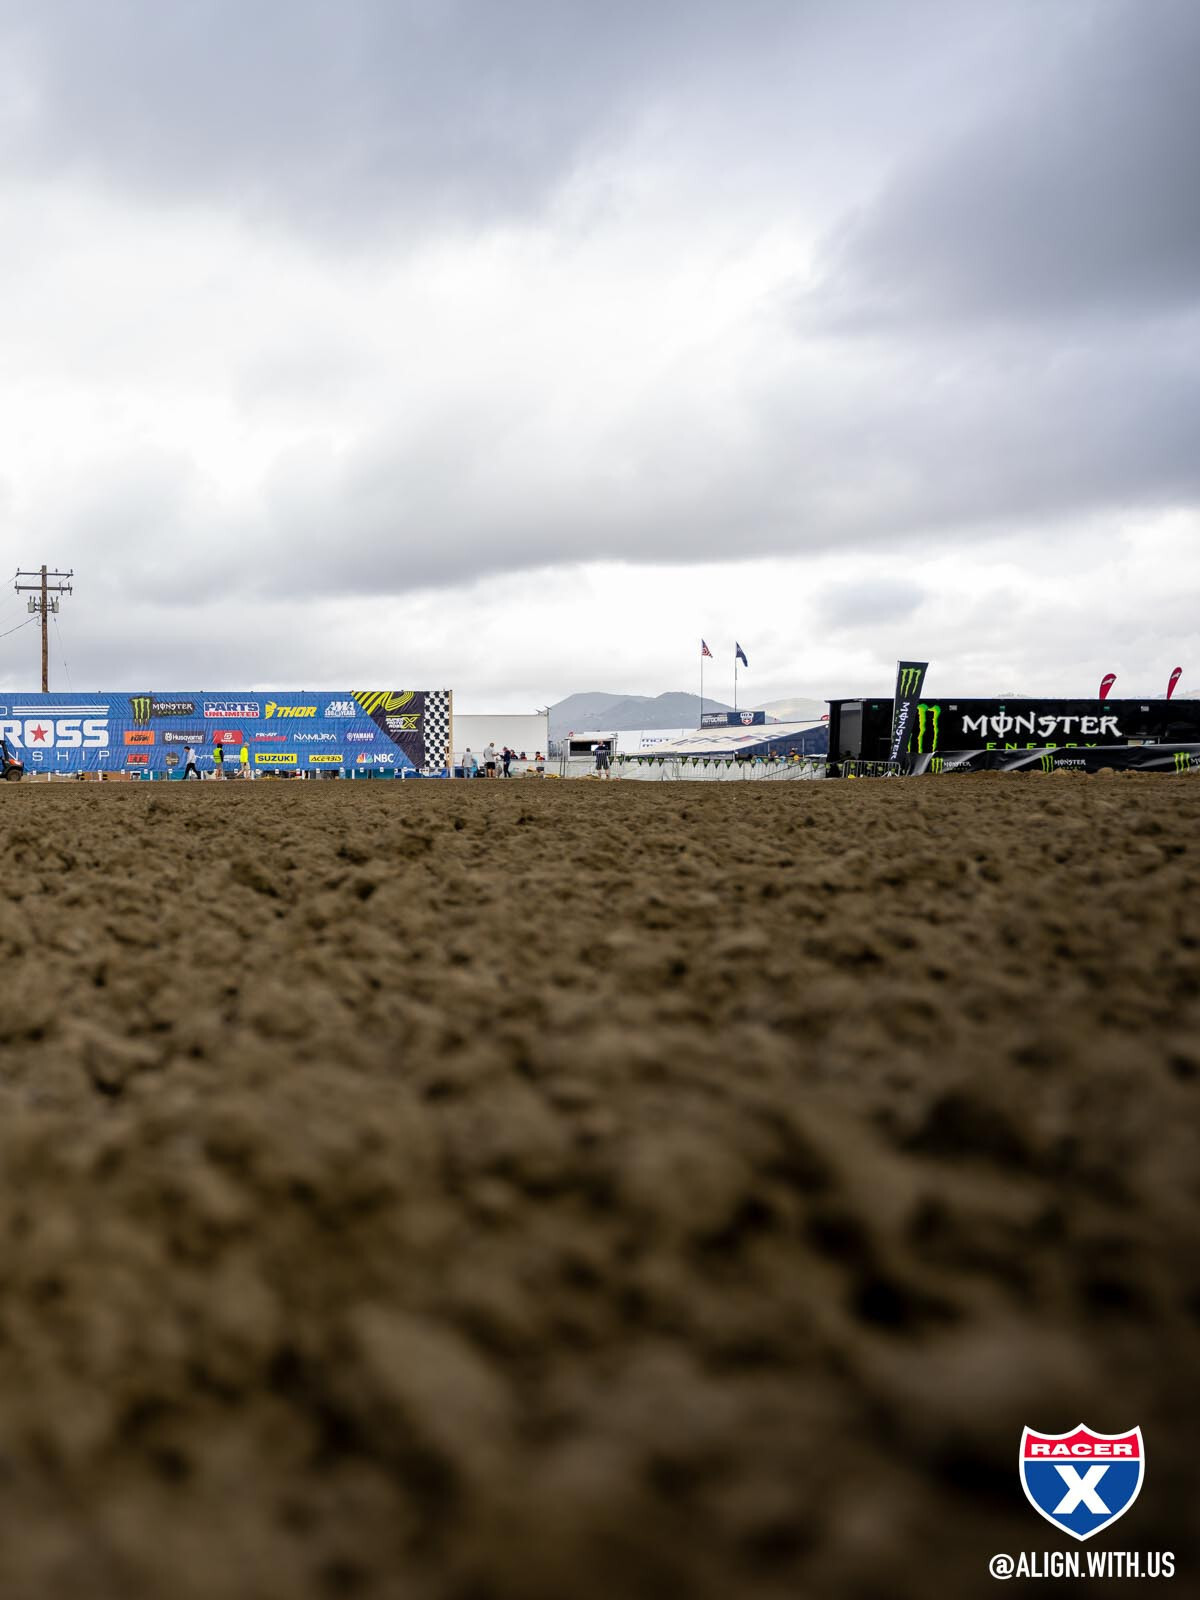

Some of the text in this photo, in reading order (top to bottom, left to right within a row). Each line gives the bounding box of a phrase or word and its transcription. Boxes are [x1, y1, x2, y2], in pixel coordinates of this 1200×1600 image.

[152, 703, 194, 711] MONSTER
[204, 703, 259, 712] PARTS
[325, 701, 355, 711] AMA
[276, 706, 318, 718] THOR
[962, 711, 1123, 738] MONSTER
[890, 702, 910, 760] MONSTER
[293, 732, 337, 742] NAMURA
[373, 753, 395, 763] NBC
[1054, 759, 1086, 767] MONSTER
